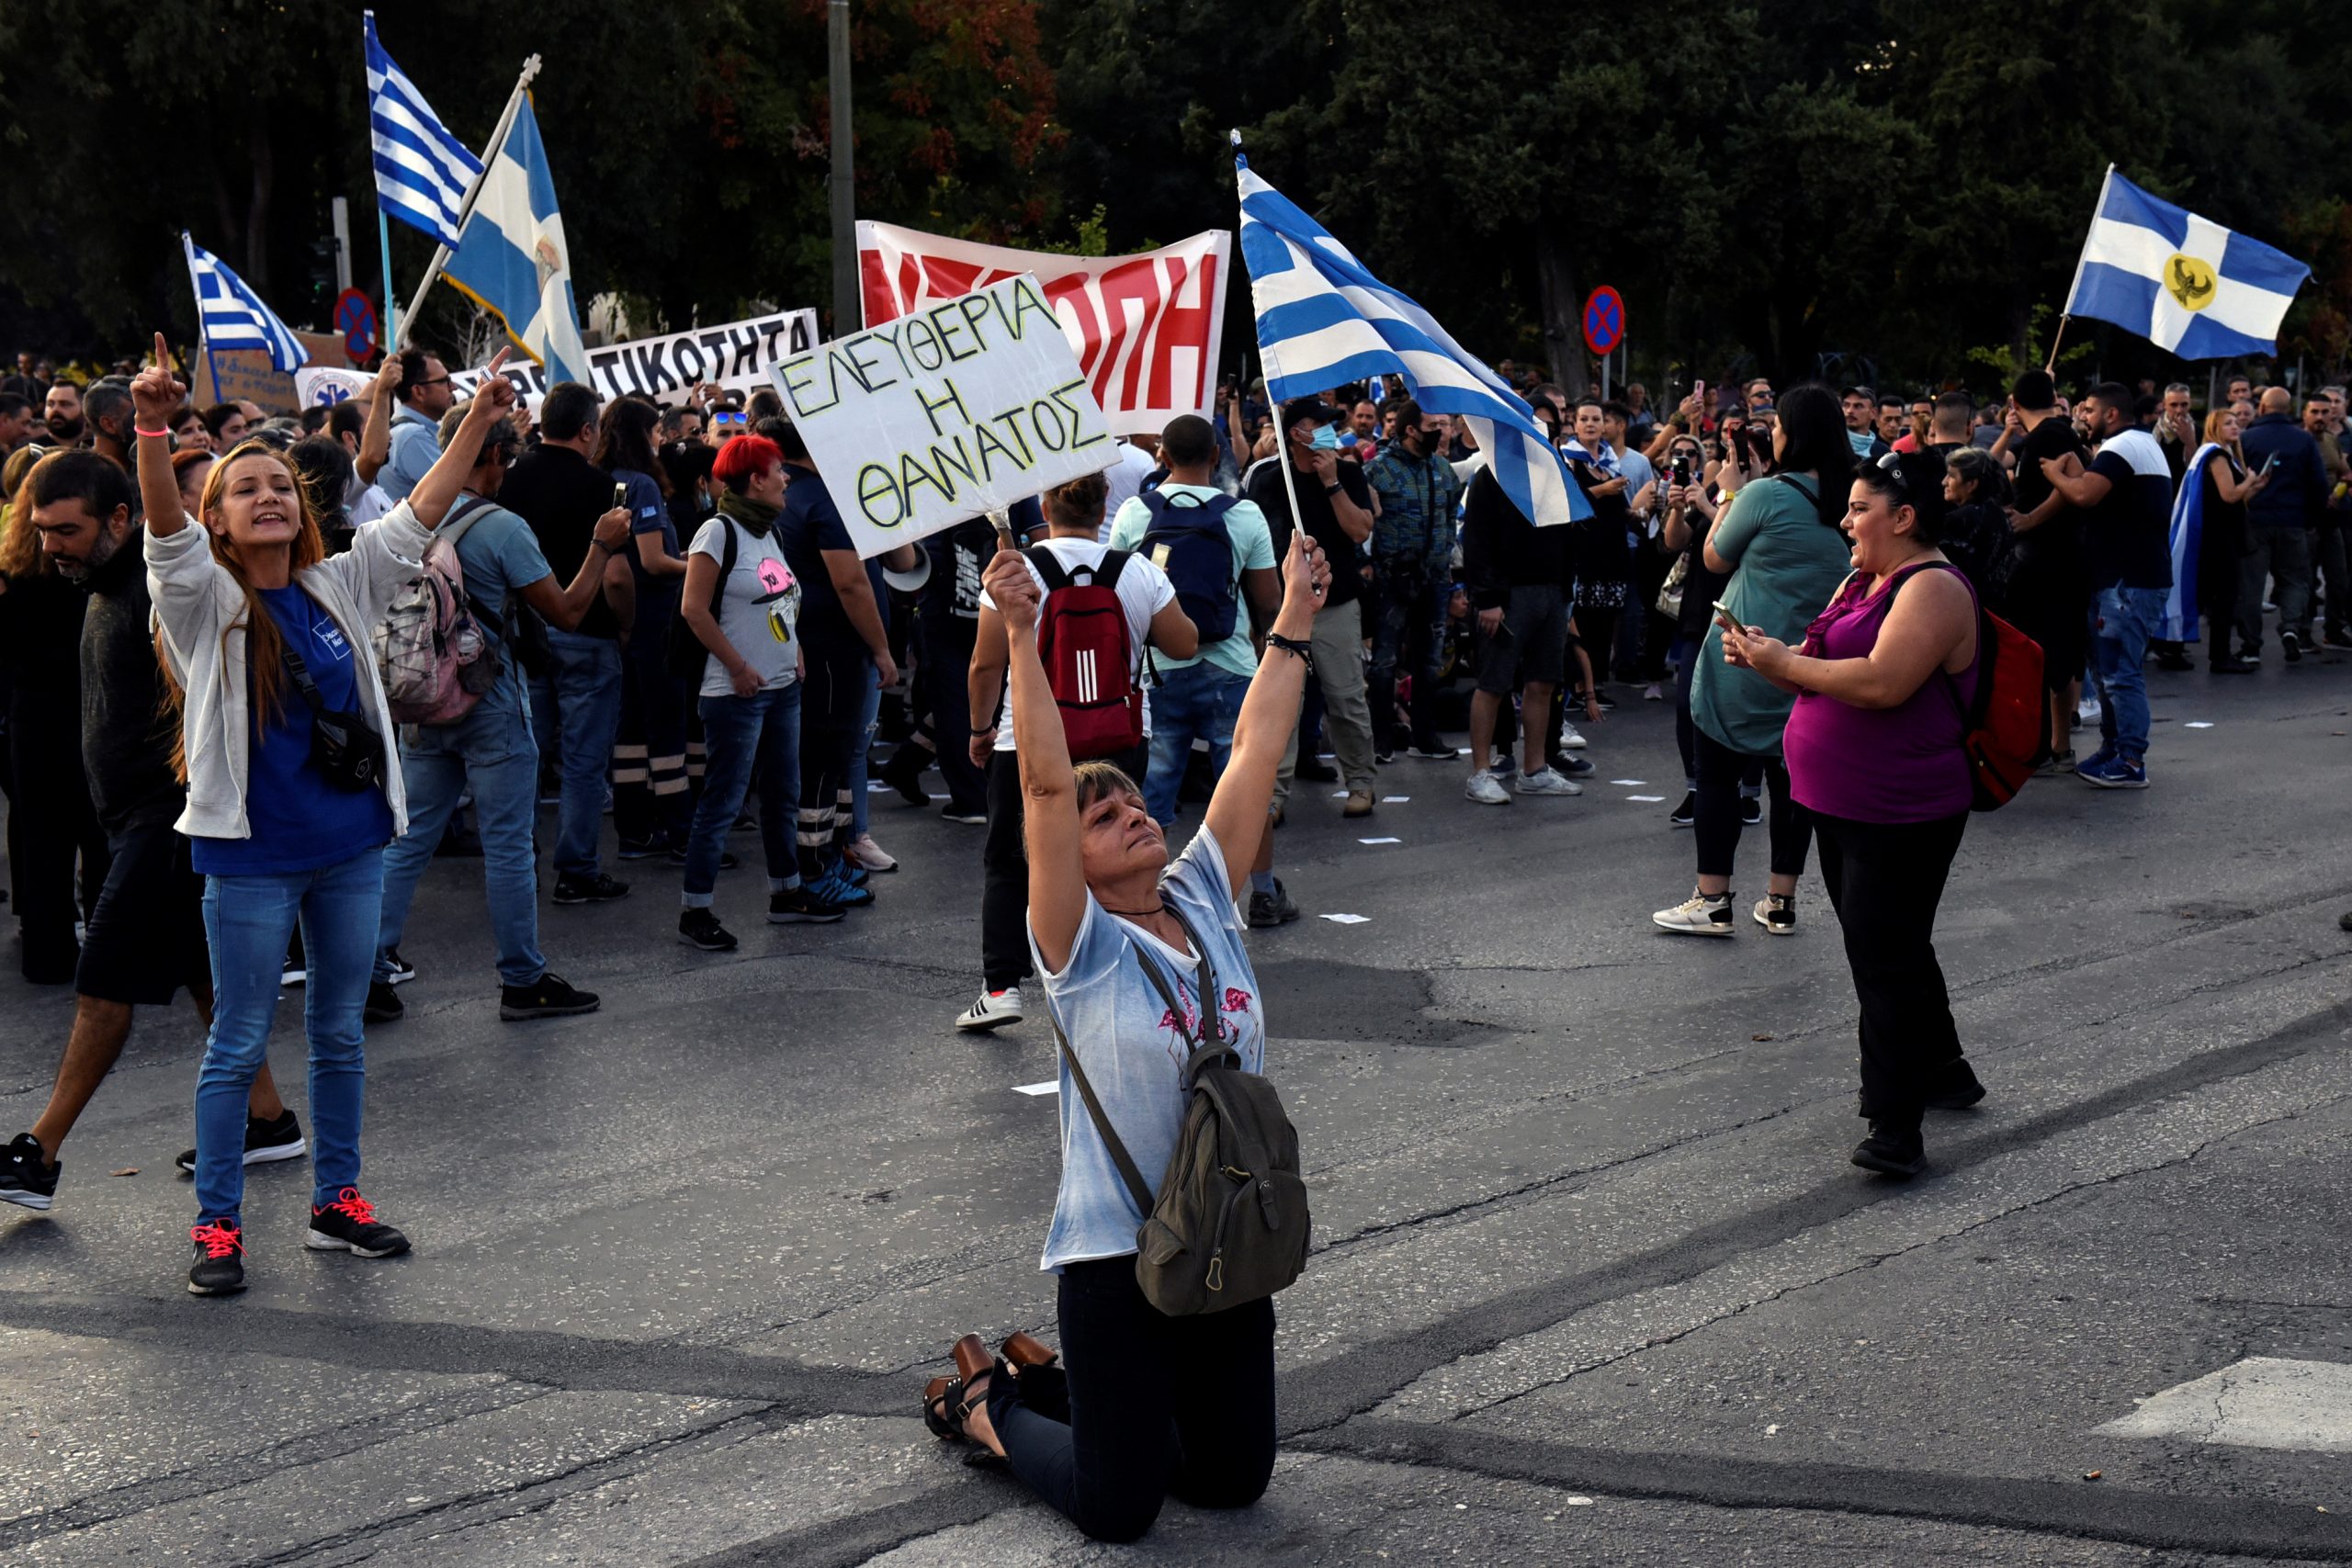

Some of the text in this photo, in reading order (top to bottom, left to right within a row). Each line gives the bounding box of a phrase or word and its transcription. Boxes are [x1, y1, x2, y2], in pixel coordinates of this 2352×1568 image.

[780, 278, 1062, 418] ΕΛΕΥΘΕΡΙΑ
[860, 249, 1217, 412] ΟΠΗ
[857, 378, 1107, 527] ΘΑΝΑΤΟΣ
[915, 378, 971, 436] Η
[762, 571, 779, 588] YO!
